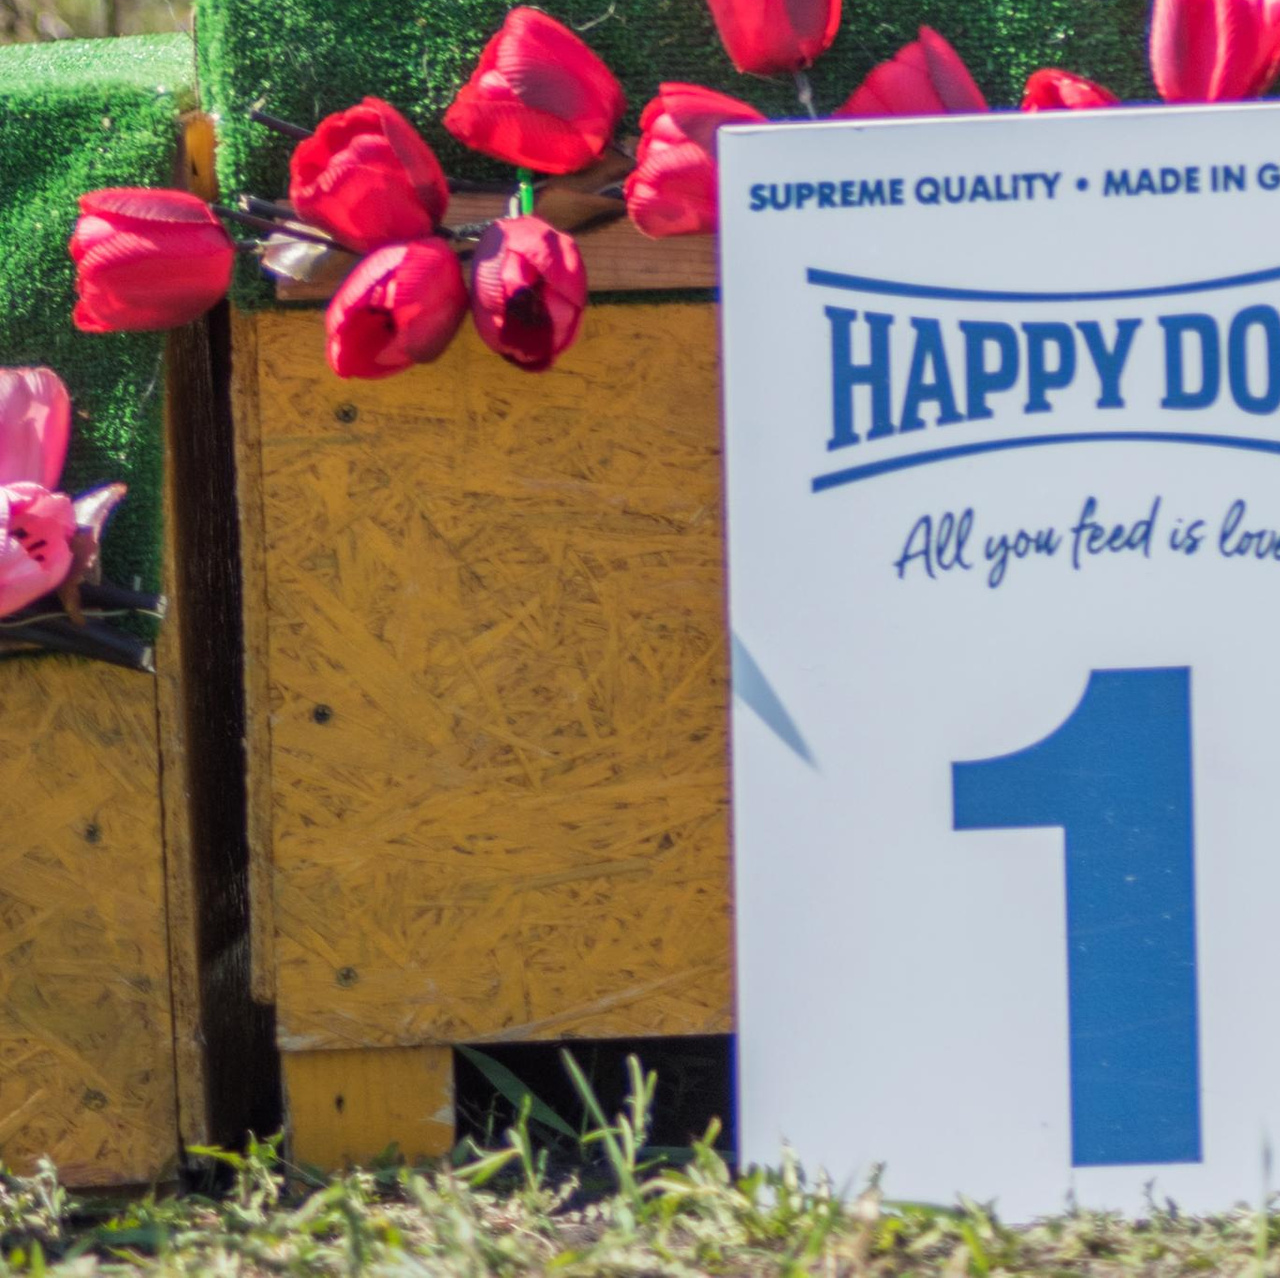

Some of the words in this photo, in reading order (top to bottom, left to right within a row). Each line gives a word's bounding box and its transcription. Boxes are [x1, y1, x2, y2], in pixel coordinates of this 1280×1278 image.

[748, 177, 905, 212] SUPREME
[914, 171, 1062, 206] QUALITY
[1102, 166, 1201, 198] MADE
[1210, 163, 1248, 194] IN
[823, 303, 1144, 453] HAPPY
[892, 506, 976, 580] All
[983, 524, 1063, 590] you
[1070, 494, 1162, 572] feed
[1168, 516, 1206, 556] is
[950, 664, 1204, 1168] 1
